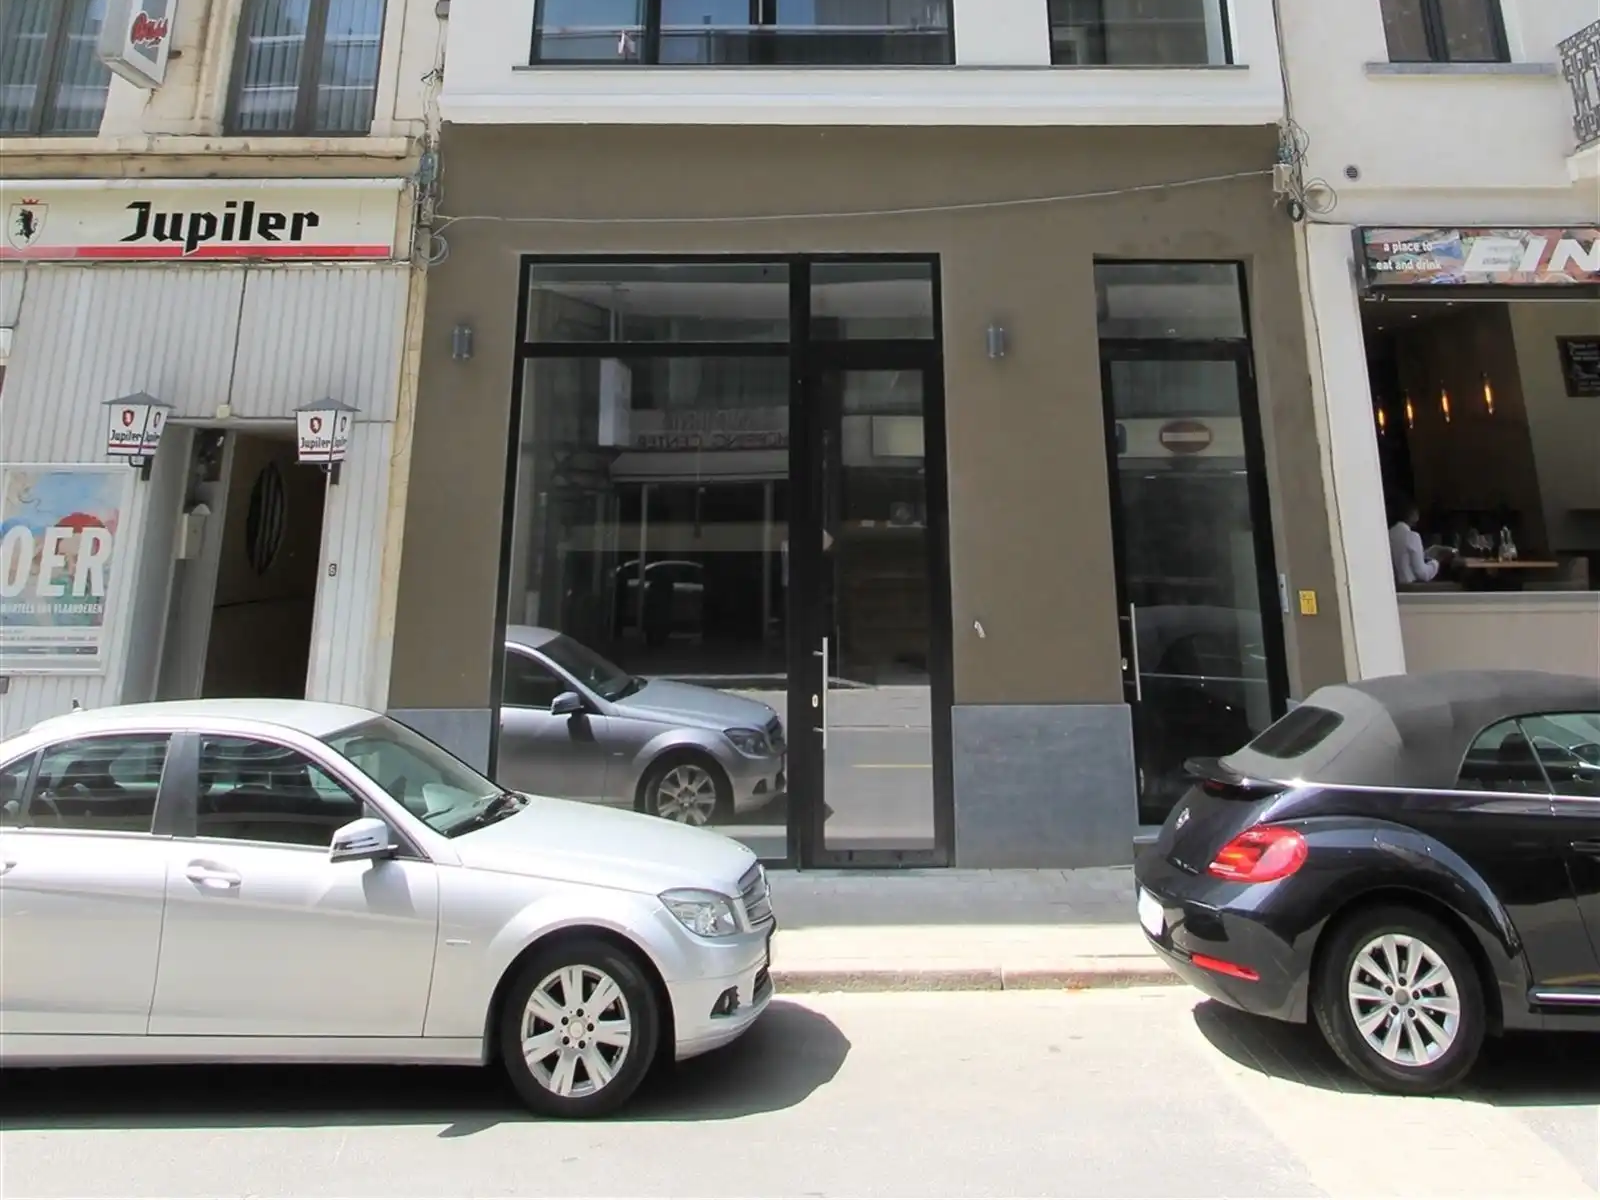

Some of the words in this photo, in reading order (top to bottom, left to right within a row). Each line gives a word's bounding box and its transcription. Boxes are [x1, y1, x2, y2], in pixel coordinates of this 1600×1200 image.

[119, 201, 319, 255] Jupiler
[1383, 242, 1390, 252] a
[1391, 240, 1420, 254] place
[1422, 240, 1433, 252] to
[1375, 259, 1393, 270] eat
[1395, 259, 1414, 270] and
[1415, 259, 1442, 271] drink
[110, 429, 142, 443] Jupiler
[300, 436, 331, 450] Jupiler
